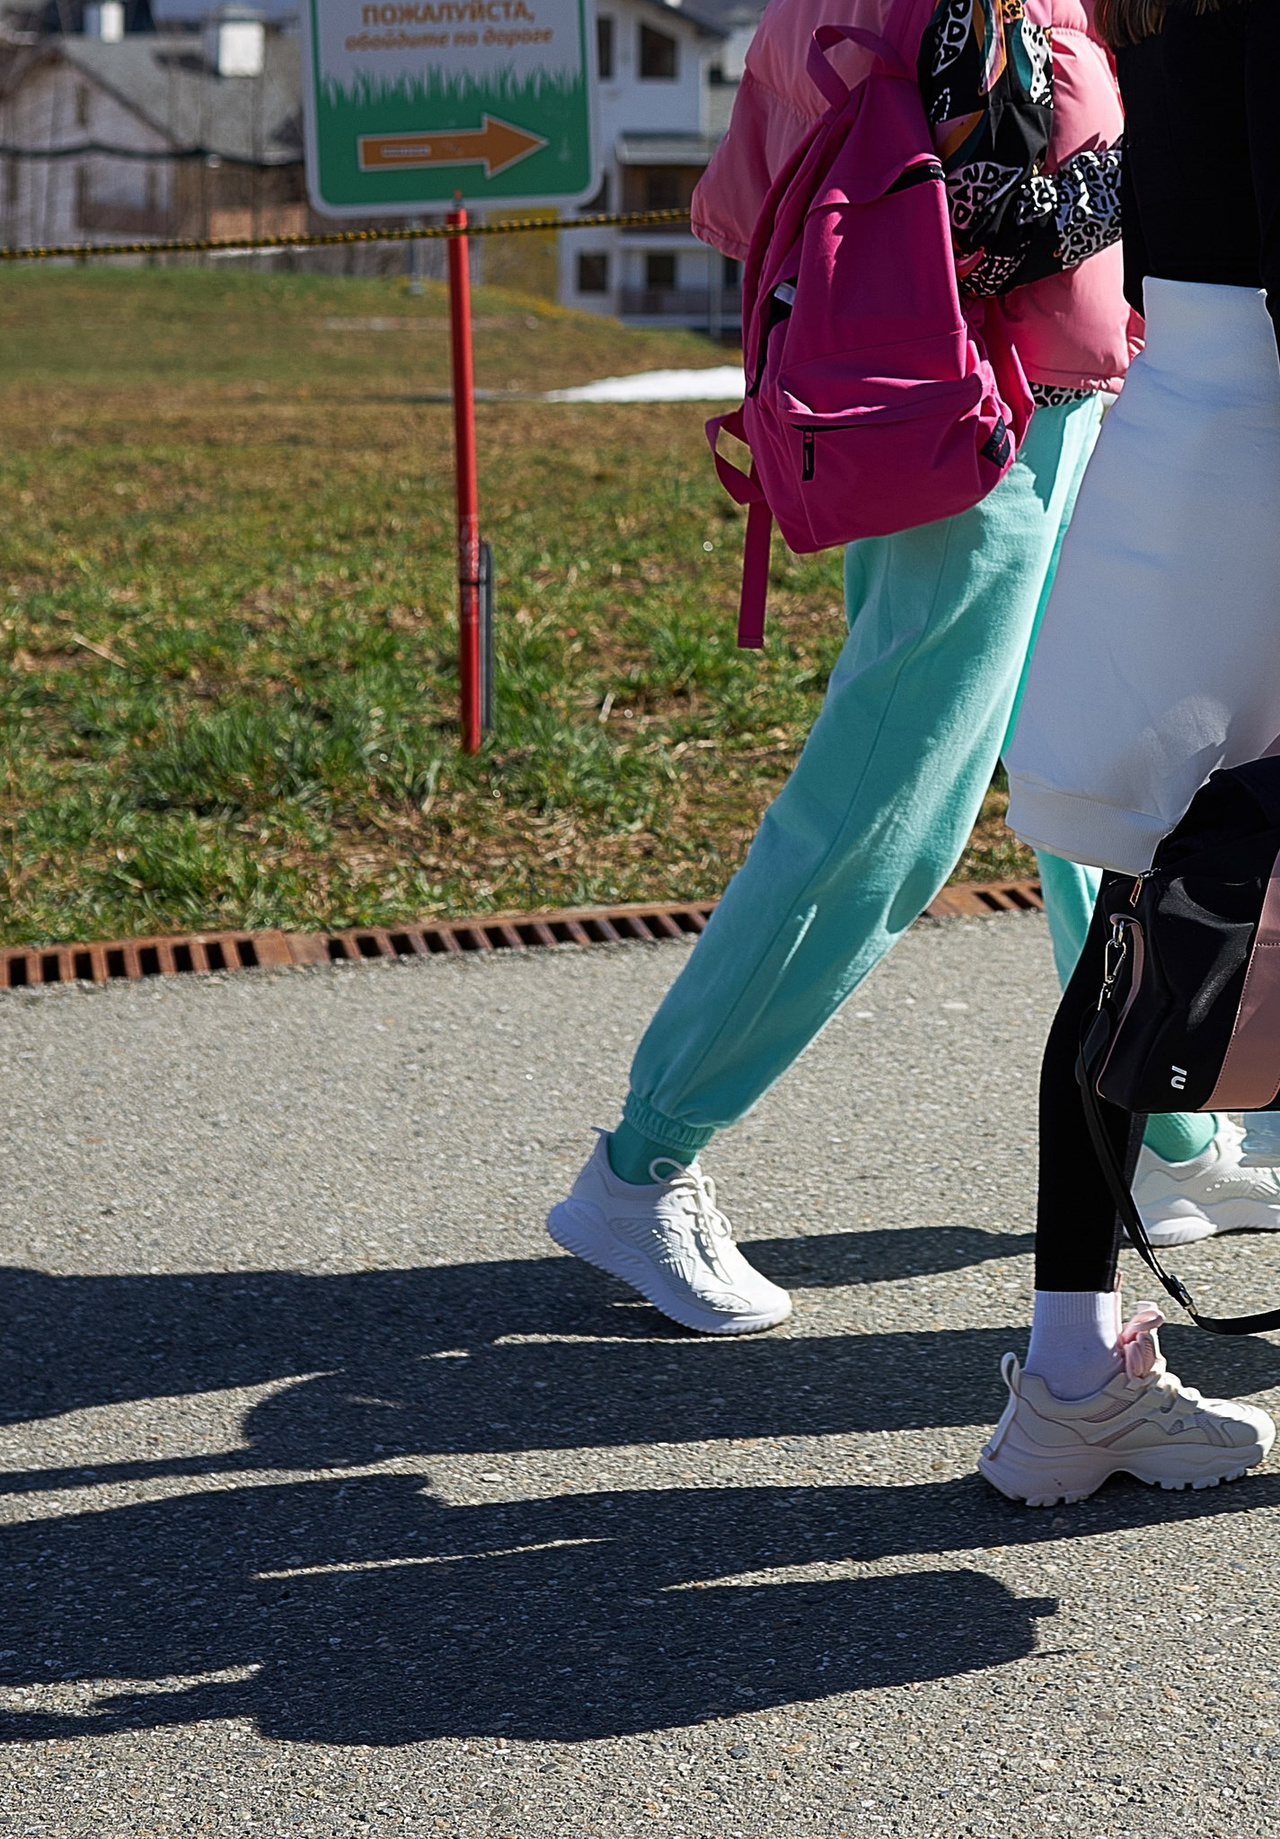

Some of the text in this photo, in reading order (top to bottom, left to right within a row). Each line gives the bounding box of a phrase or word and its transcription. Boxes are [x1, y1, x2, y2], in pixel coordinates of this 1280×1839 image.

[346, 27, 553, 50] обойдите по дороге
